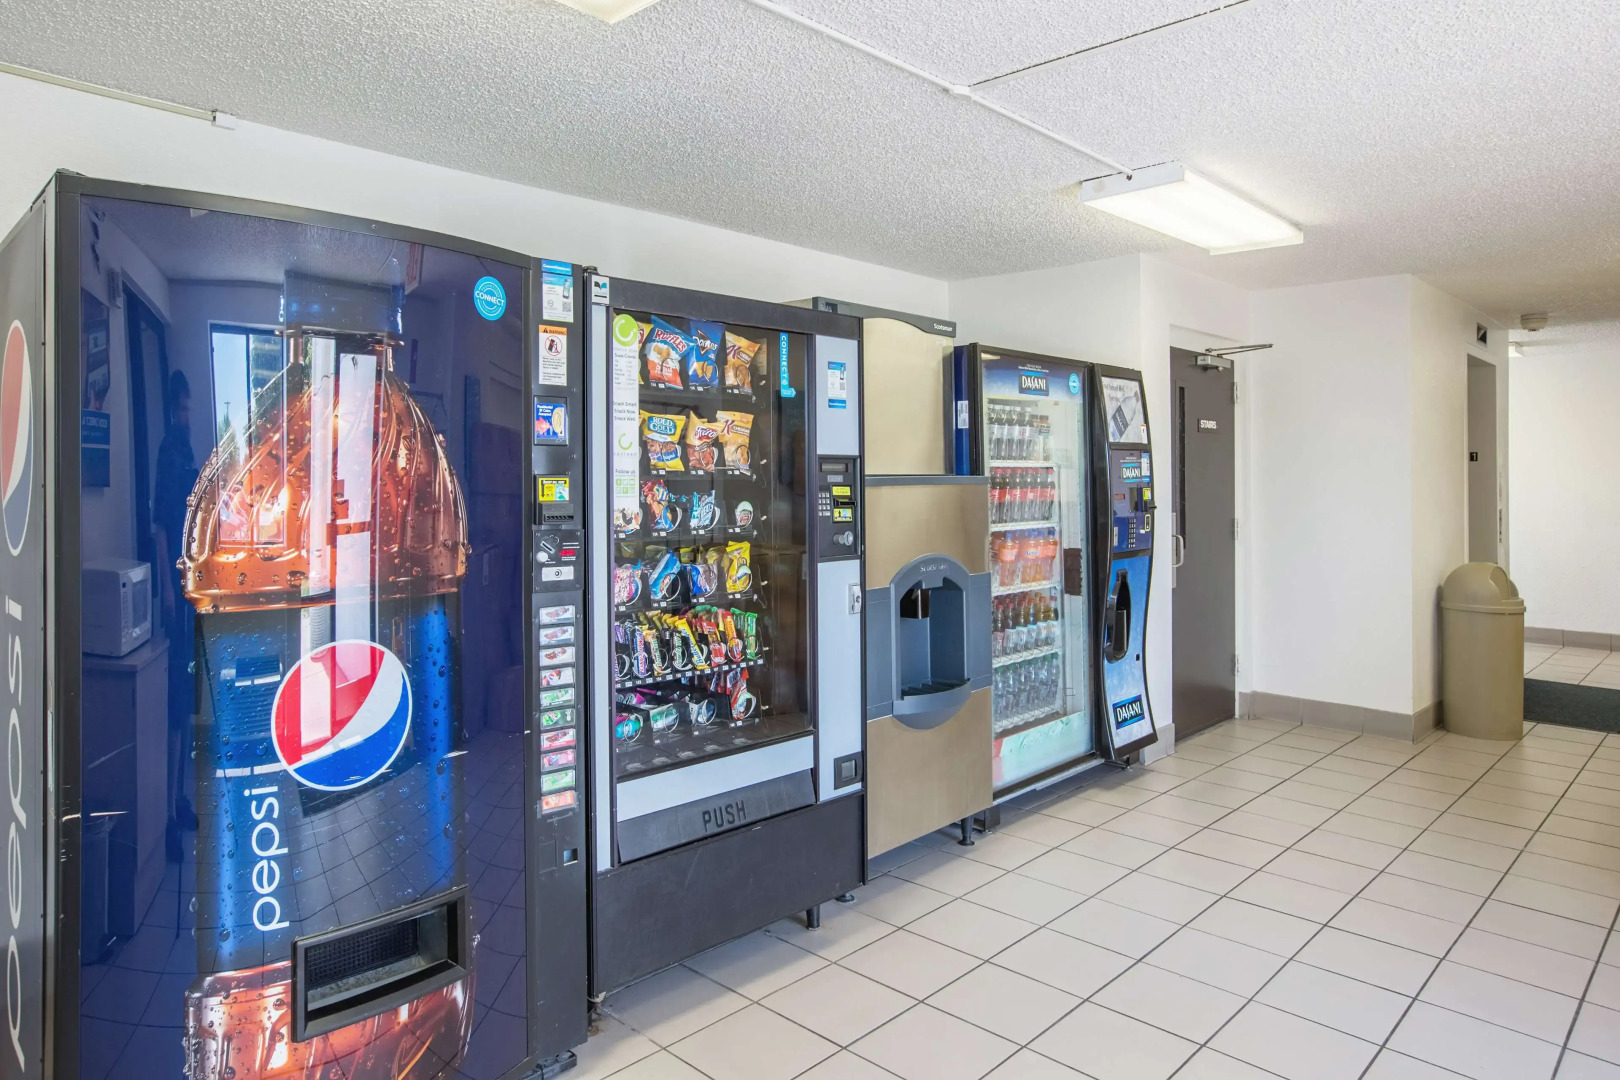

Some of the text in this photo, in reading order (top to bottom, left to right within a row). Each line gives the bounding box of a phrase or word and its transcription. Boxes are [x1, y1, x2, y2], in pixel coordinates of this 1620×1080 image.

[474, 290, 505, 306] CONNECT
[653, 328, 688, 354] RUFFLES
[1021, 375, 1047, 391] DASANI
[650, 422, 676, 435] GOLD
[653, 416, 673, 427] ROLD
[1200, 419, 1217, 429] STAIRS
[1122, 466, 1141, 480] DASANI
[1115, 701, 1143, 722] DASANI
[702, 799, 747, 833] PUSH
[5, 594, 27, 1073] pepsi
[243, 785, 290, 931] pepsi
